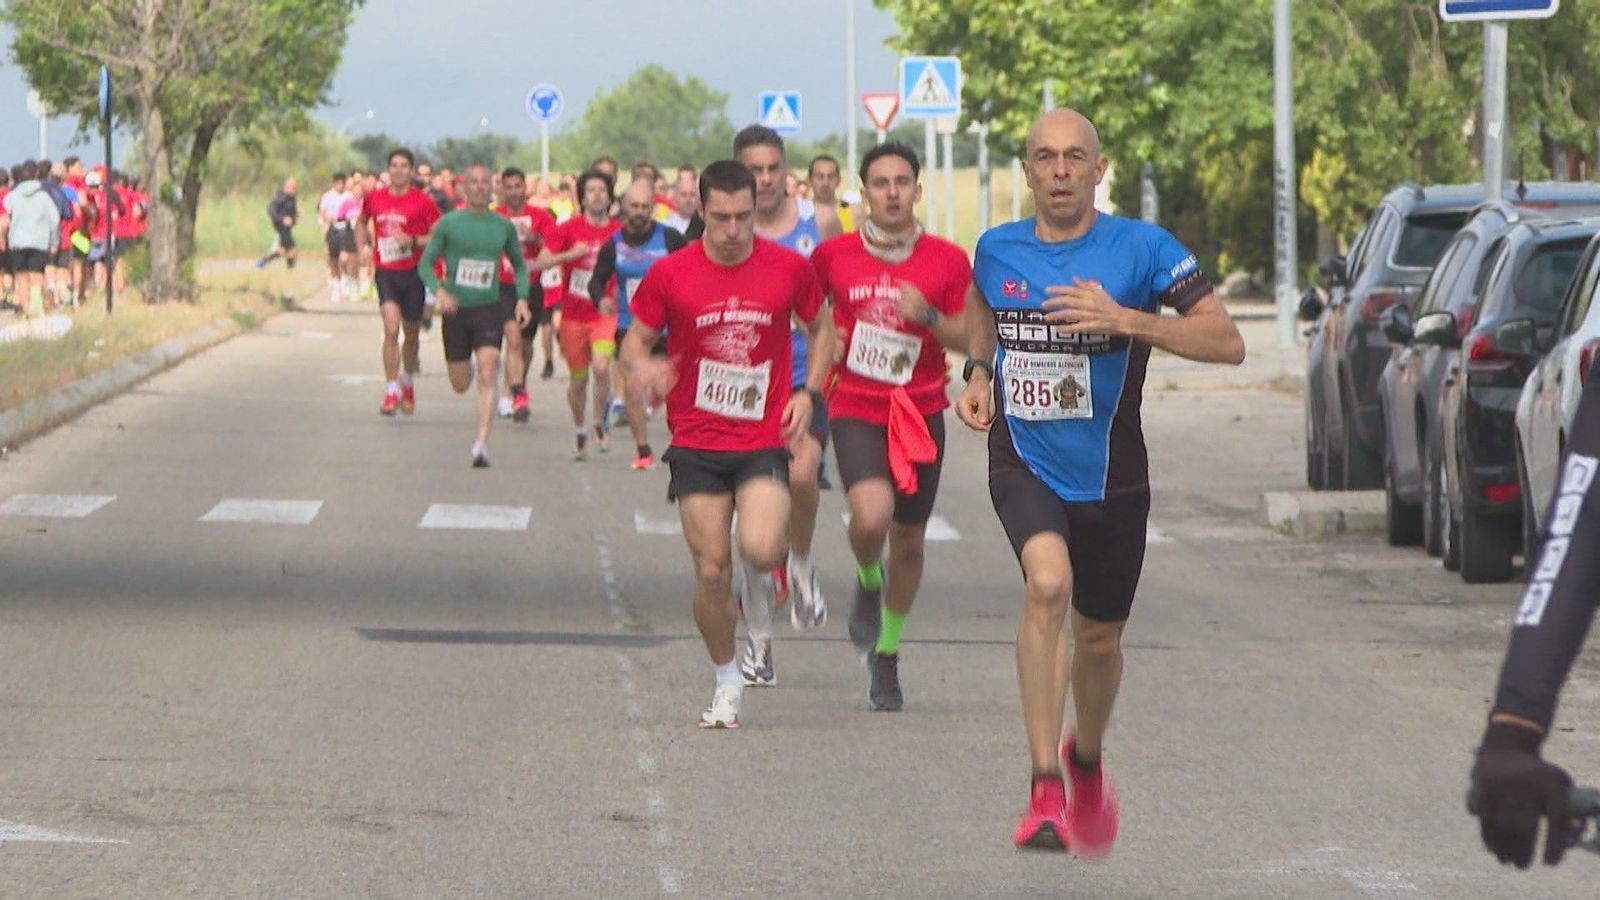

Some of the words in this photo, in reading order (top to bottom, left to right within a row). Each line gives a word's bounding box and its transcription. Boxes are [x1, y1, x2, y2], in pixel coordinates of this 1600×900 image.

[857, 343, 888, 368] 305
[704, 381, 739, 406] 460
[1011, 378, 1051, 408] 285
